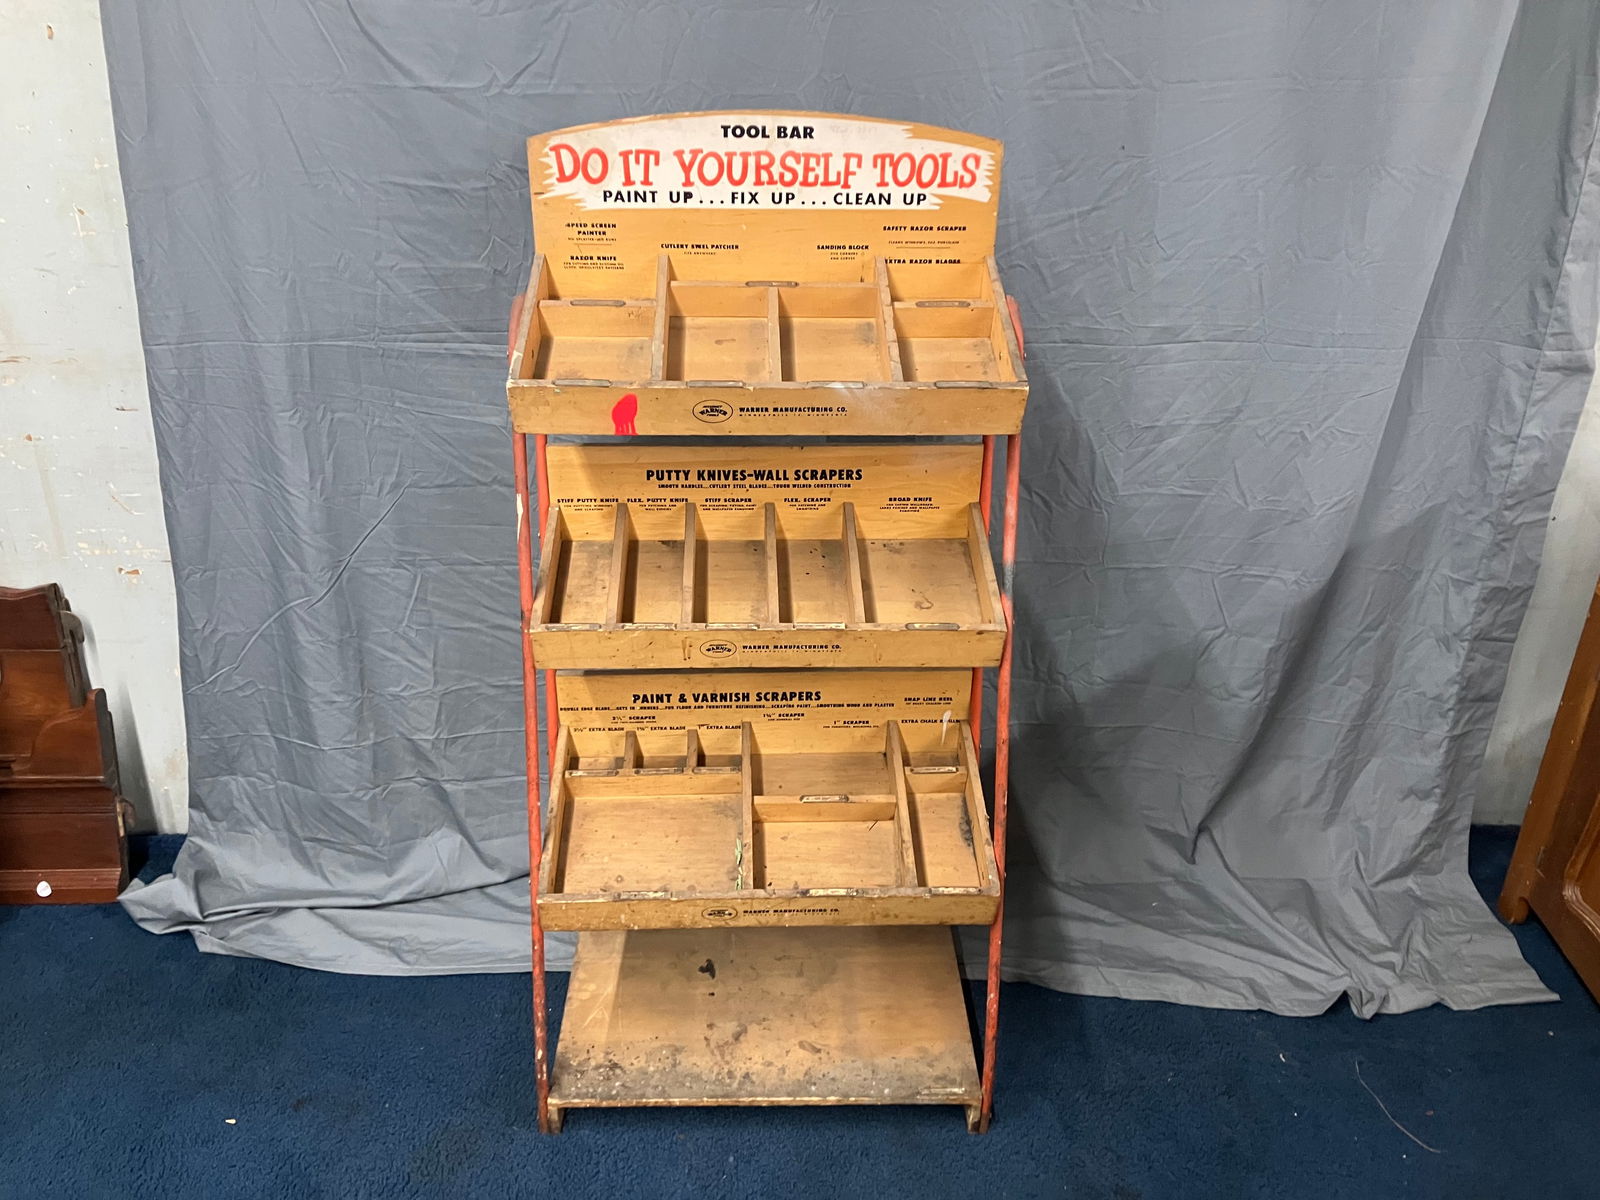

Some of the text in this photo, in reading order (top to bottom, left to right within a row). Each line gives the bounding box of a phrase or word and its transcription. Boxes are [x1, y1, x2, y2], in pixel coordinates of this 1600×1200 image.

[721, 125, 815, 139] TOOL BAR
[548, 143, 981, 189] DO IT YOURSELF TOOLS
[602, 190, 658, 203] PAINT
[731, 191, 760, 204] FIX
[833, 192, 892, 205] CLEAN
[903, 193, 927, 206] UP
[646, 468, 862, 481] PUTTY KNIVES-WALL SCRAPERS
[632, 691, 822, 703] PAINT & VARNISH SCRAPERS
